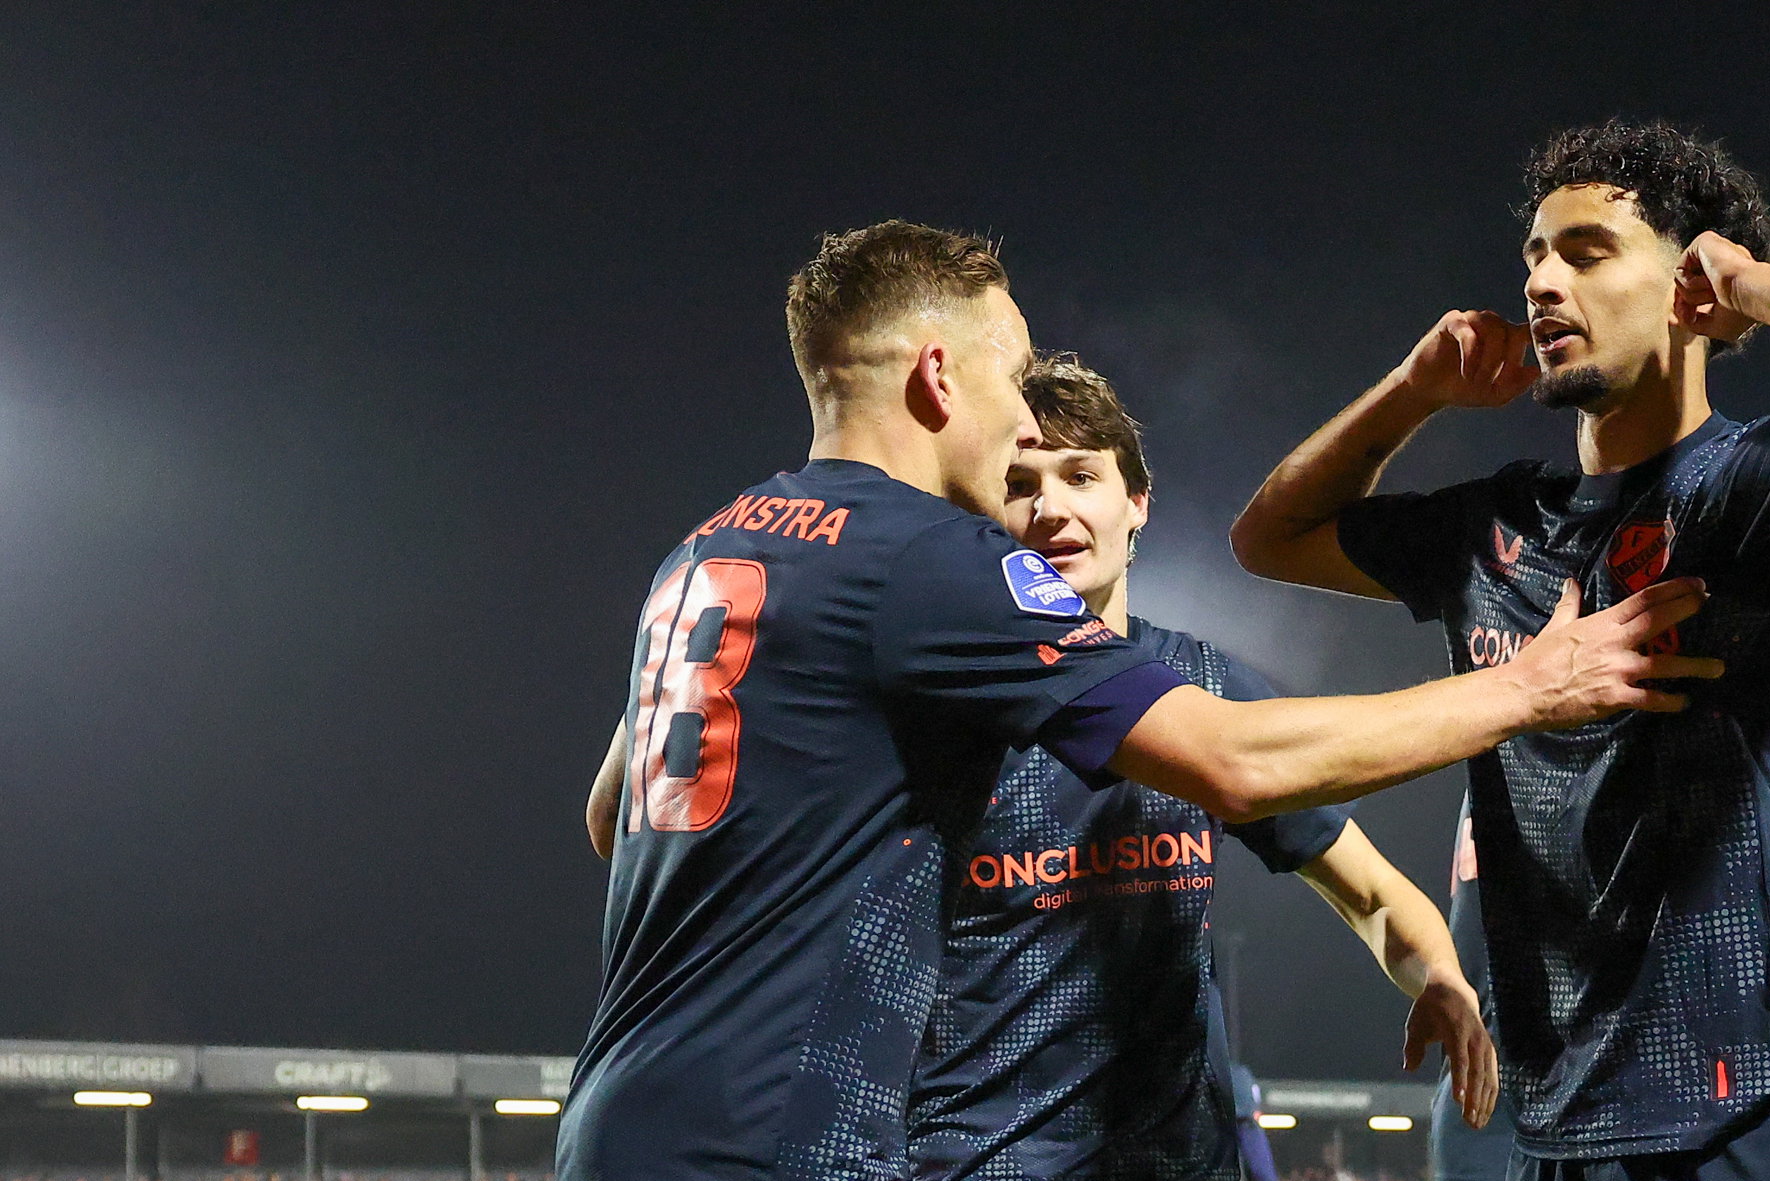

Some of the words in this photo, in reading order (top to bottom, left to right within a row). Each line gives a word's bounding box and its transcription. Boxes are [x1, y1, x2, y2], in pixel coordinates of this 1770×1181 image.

[684, 495, 850, 545] NSTRA
[627, 557, 767, 833] 18
[966, 830, 1213, 889] ONCLUSION
